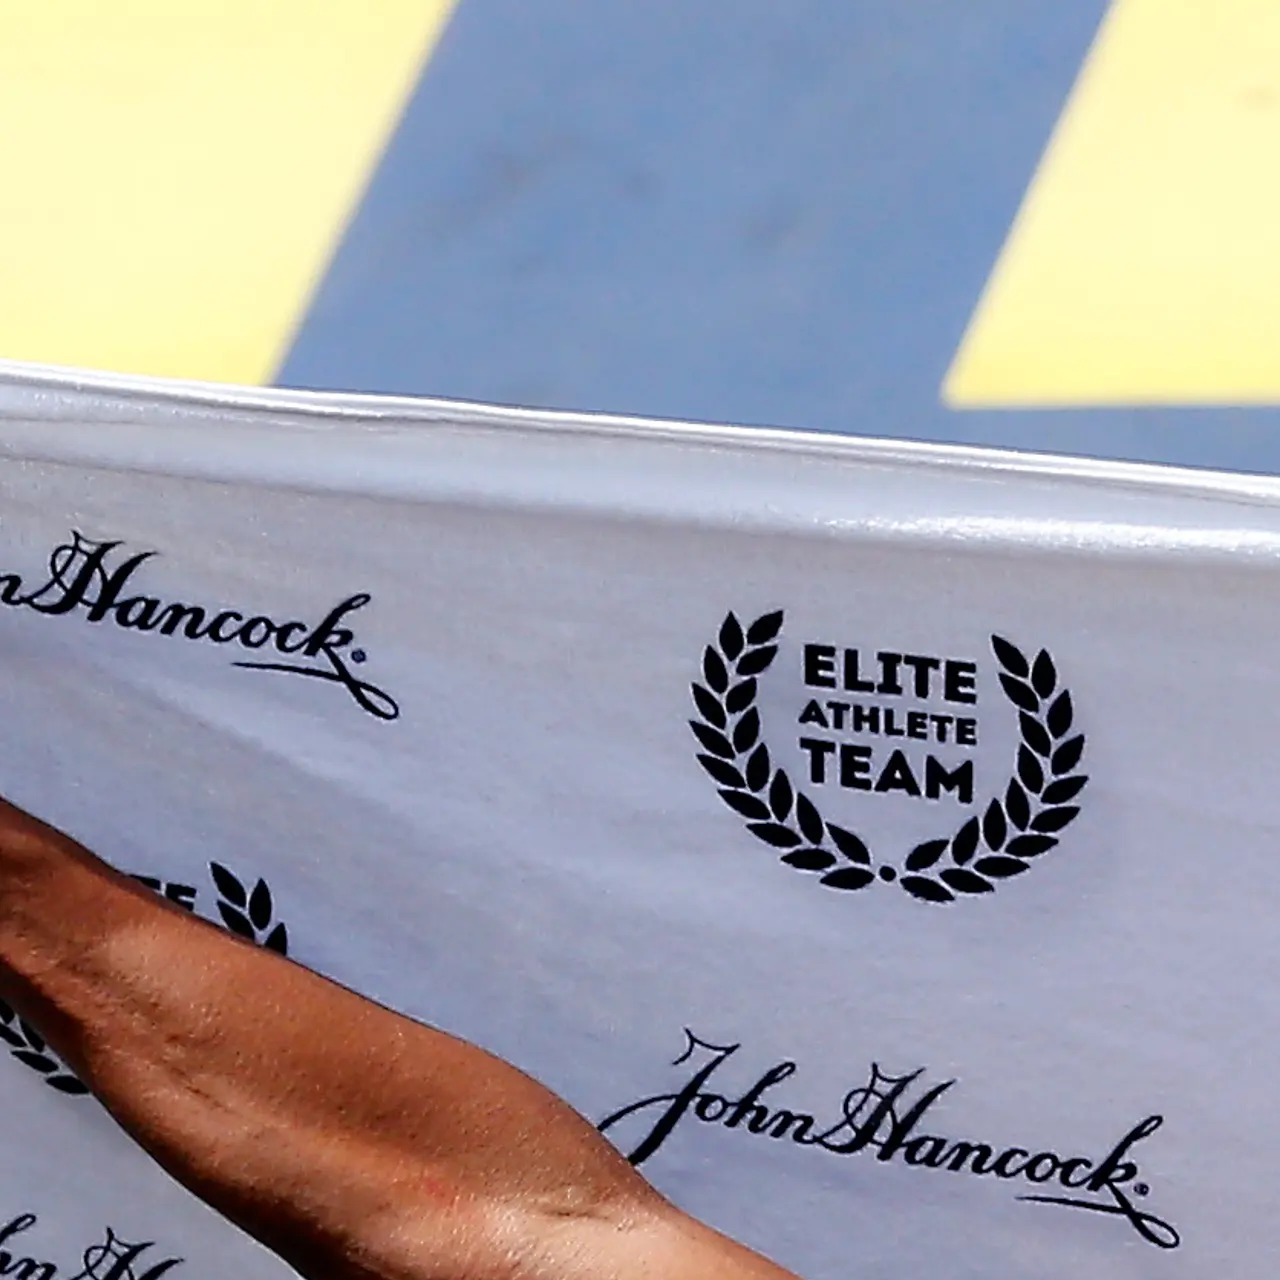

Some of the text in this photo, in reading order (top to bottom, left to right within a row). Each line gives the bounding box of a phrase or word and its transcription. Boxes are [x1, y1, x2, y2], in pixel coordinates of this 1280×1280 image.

[803, 644, 979, 705] ELITE
[799, 700, 978, 746] ATHLETE
[800, 738, 976, 804] TEAM
[599, 1027, 1180, 1249] John Hancock
